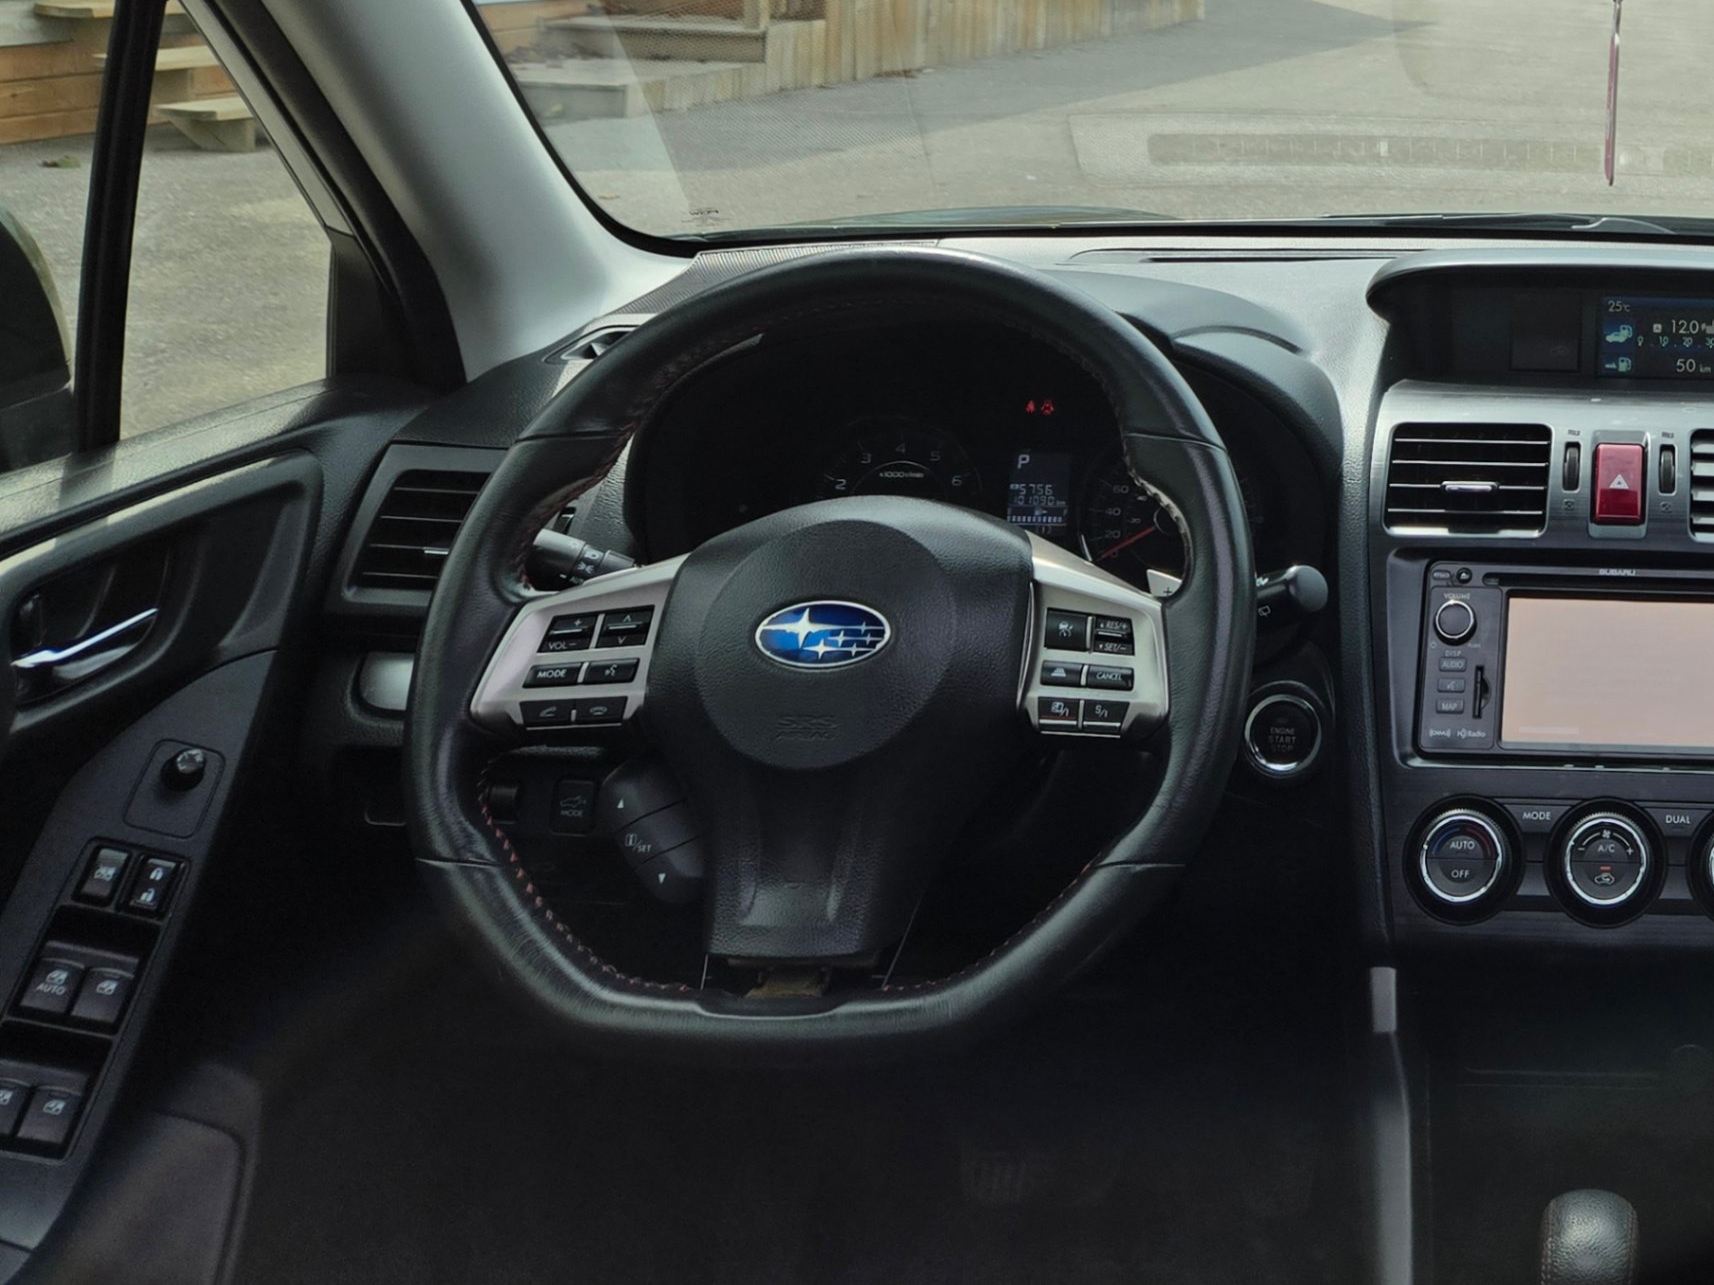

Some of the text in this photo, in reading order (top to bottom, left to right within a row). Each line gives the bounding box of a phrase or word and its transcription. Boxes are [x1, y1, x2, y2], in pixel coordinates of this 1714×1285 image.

[1671, 319, 1700, 334] 12.0
[1676, 358, 1697, 373] 50
[860, 452, 872, 464] 3
[1017, 454, 1031, 470] P
[834, 478, 847, 491] 2
[951, 475, 963, 487] 6
[1443, 592, 1471, 600] VOLUME
[1441, 660, 1464, 669] AUDIO
[536, 669, 567, 679] MODE
[1096, 671, 1122, 681] CANCEL
[1441, 702, 1458, 711] MAP
[1269, 726, 1296, 735] ENGINE
[1267, 735, 1297, 744] START
[1522, 810, 1551, 821] MODE
[1665, 814, 1691, 825] DUAL
[1449, 840, 1476, 851] AUTO
[1597, 843, 1616, 854] A/C
[1450, 869, 1470, 879] OFF
[35, 982, 67, 996] AUTO
